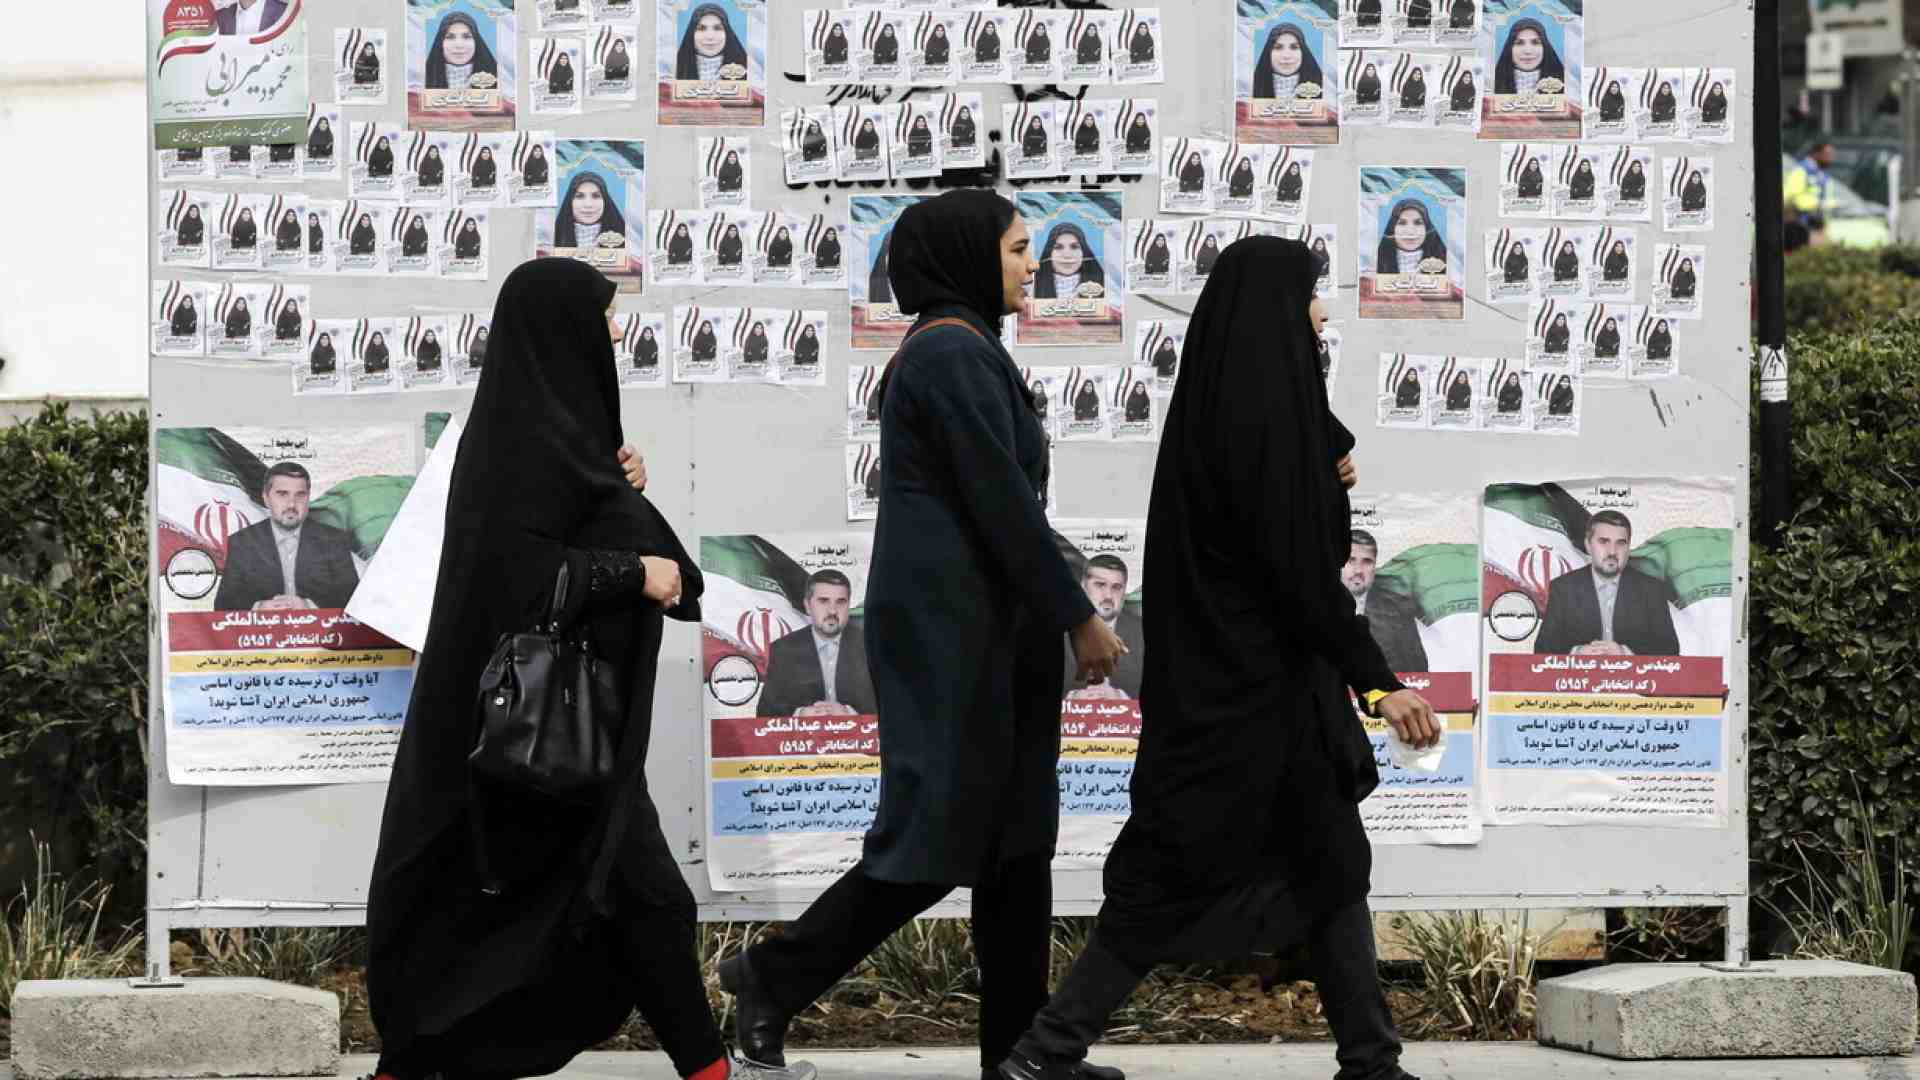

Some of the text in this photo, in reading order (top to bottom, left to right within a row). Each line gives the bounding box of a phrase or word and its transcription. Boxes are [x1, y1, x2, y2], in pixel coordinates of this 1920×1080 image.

[212, 611, 280, 631] عبدالملکی
[284, 612, 317, 626] حمید
[276, 633, 320, 648] انتخاباتی
[1531, 656, 1681, 674] مهندس حمید عبدالملکی
[200, 672, 378, 691] آیا وقت آن نرسیده که با قانون اساسی
[1592, 679, 1632, 692] انتخاباتی
[240, 696, 260, 706] آشنا
[264, 695, 290, 709] ایران
[292, 695, 327, 708] اسلامی
[330, 695, 369, 708] جمهوری
[1062, 700, 1128, 717] حمید عبدال
[755, 719, 821, 736] عبدالملکی
[825, 721, 857, 733] حمید
[1088, 724, 1130, 737] انتخاباتی
[1517, 719, 1689, 733] آیا وقت آن نرسیده که با قانون اساسی
[817, 739, 858, 754] انتخاباتی
[1555, 738, 1574, 748] آشنا
[1578, 739, 1603, 752] ایران
[1605, 739, 1638, 751] اسلامی
[1641, 739, 1680, 752] جمهوری
[1075, 765, 1081, 775] با
[1085, 765, 1095, 775] که
[743, 784, 773, 797] اساسی
[776, 782, 801, 796] قانون
[805, 782, 811, 791] با
[815, 782, 825, 790] که
[829, 782, 861, 793] نرسیده
[1074, 784, 1099, 796] ایران
[782, 800, 801, 811] آشنا
[805, 800, 830, 814] ایران
[832, 800, 866, 814] اسلامی
